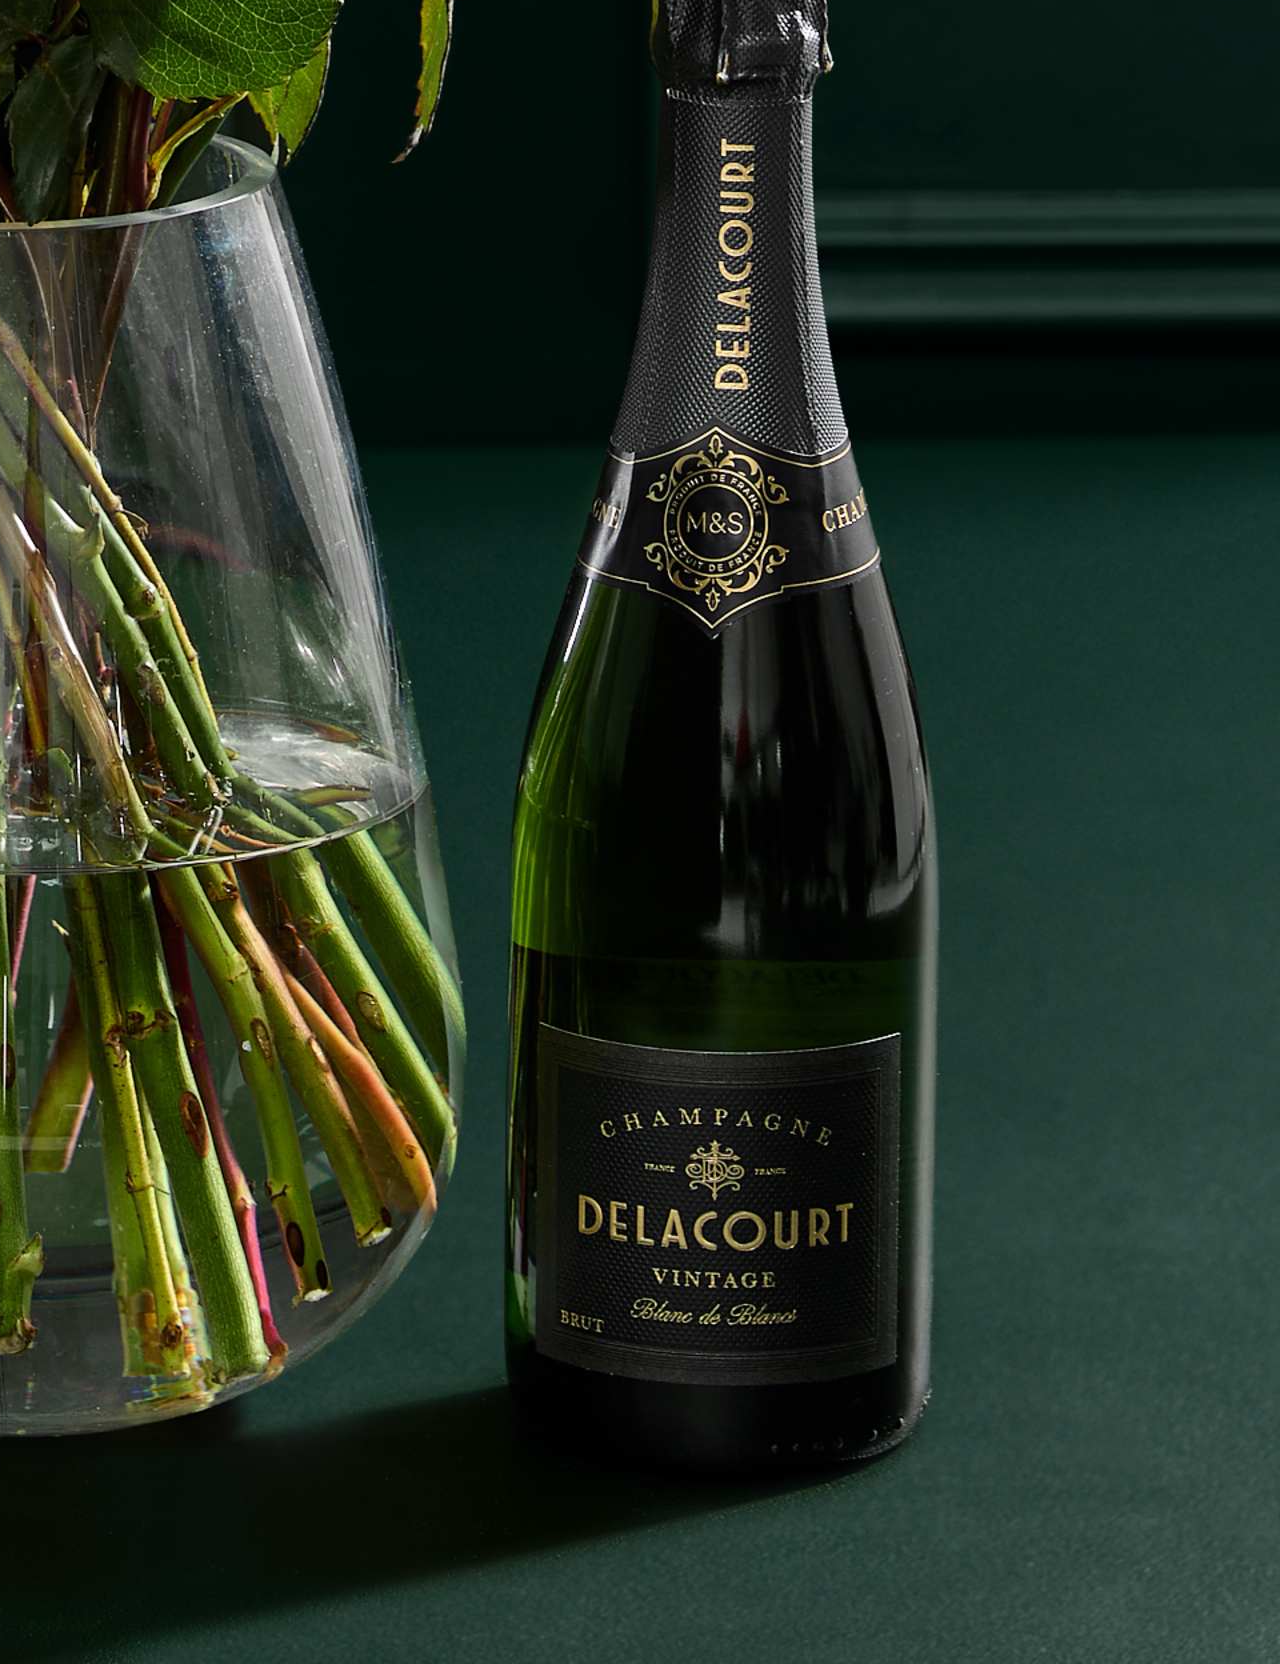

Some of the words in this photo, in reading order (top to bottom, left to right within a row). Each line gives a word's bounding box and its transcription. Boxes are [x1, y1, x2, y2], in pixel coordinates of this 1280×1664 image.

[713, 138, 755, 392] DELACOURT
[669, 475, 705, 515] PRODUIT
[710, 473, 727, 482] DE
[730, 478, 762, 516] FRANCE
[686, 511, 744, 534] M&S
[669, 529, 705, 569] PRODUIT
[708, 563, 724, 573] DE
[728, 532, 762, 568] FRANCE
[599, 1106, 834, 1148] CHAMPAGNE
[577, 1193, 855, 1252] DELACOURT
[651, 1267, 777, 1289] VINTAGE
[560, 1308, 606, 1333] BRUT
[630, 1297, 693, 1325] Blanc
[699, 1303, 722, 1325] de
[726, 1303, 798, 1327] Blancs
